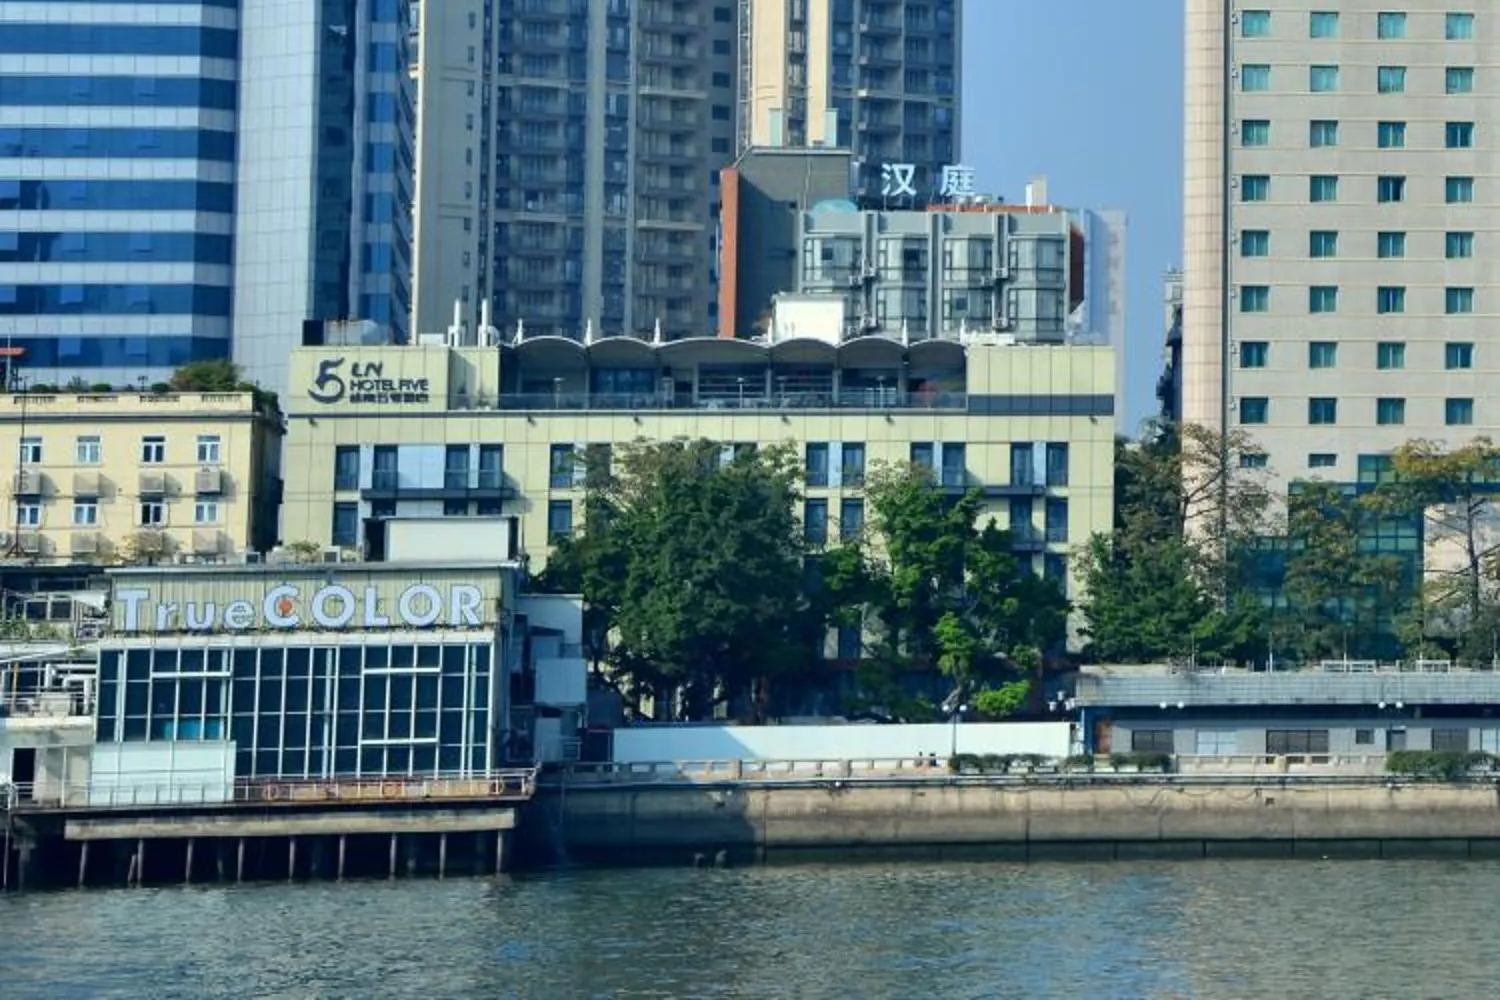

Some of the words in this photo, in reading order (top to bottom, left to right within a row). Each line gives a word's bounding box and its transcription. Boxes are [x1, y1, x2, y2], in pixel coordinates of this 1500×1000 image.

[881, 162, 976, 196] 汉庭
[308, 357, 345, 403] 5
[351, 361, 383, 377] LN
[350, 379, 396, 391] HOTEL
[399, 379, 429, 391] FIVE
